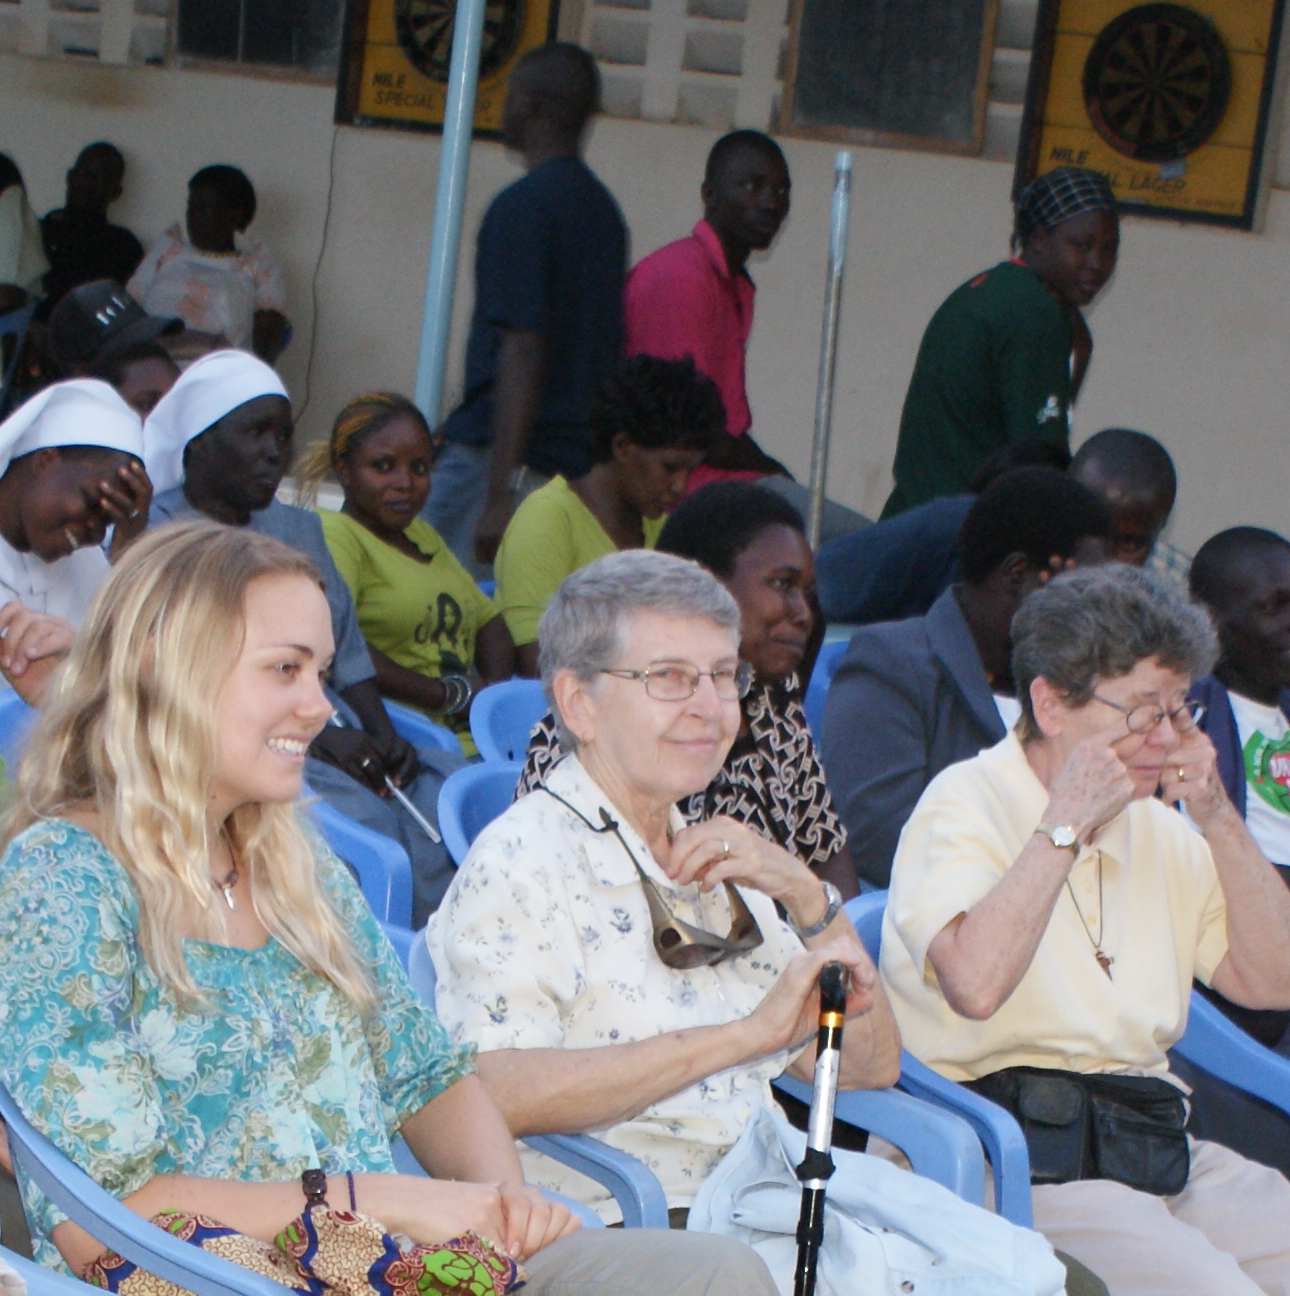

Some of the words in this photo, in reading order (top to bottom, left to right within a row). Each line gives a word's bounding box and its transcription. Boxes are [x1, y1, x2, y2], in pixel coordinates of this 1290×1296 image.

[372, 72, 407, 89] NILE
[1049, 147, 1089, 165] NILE
[1128, 173, 1187, 194] LAGER
